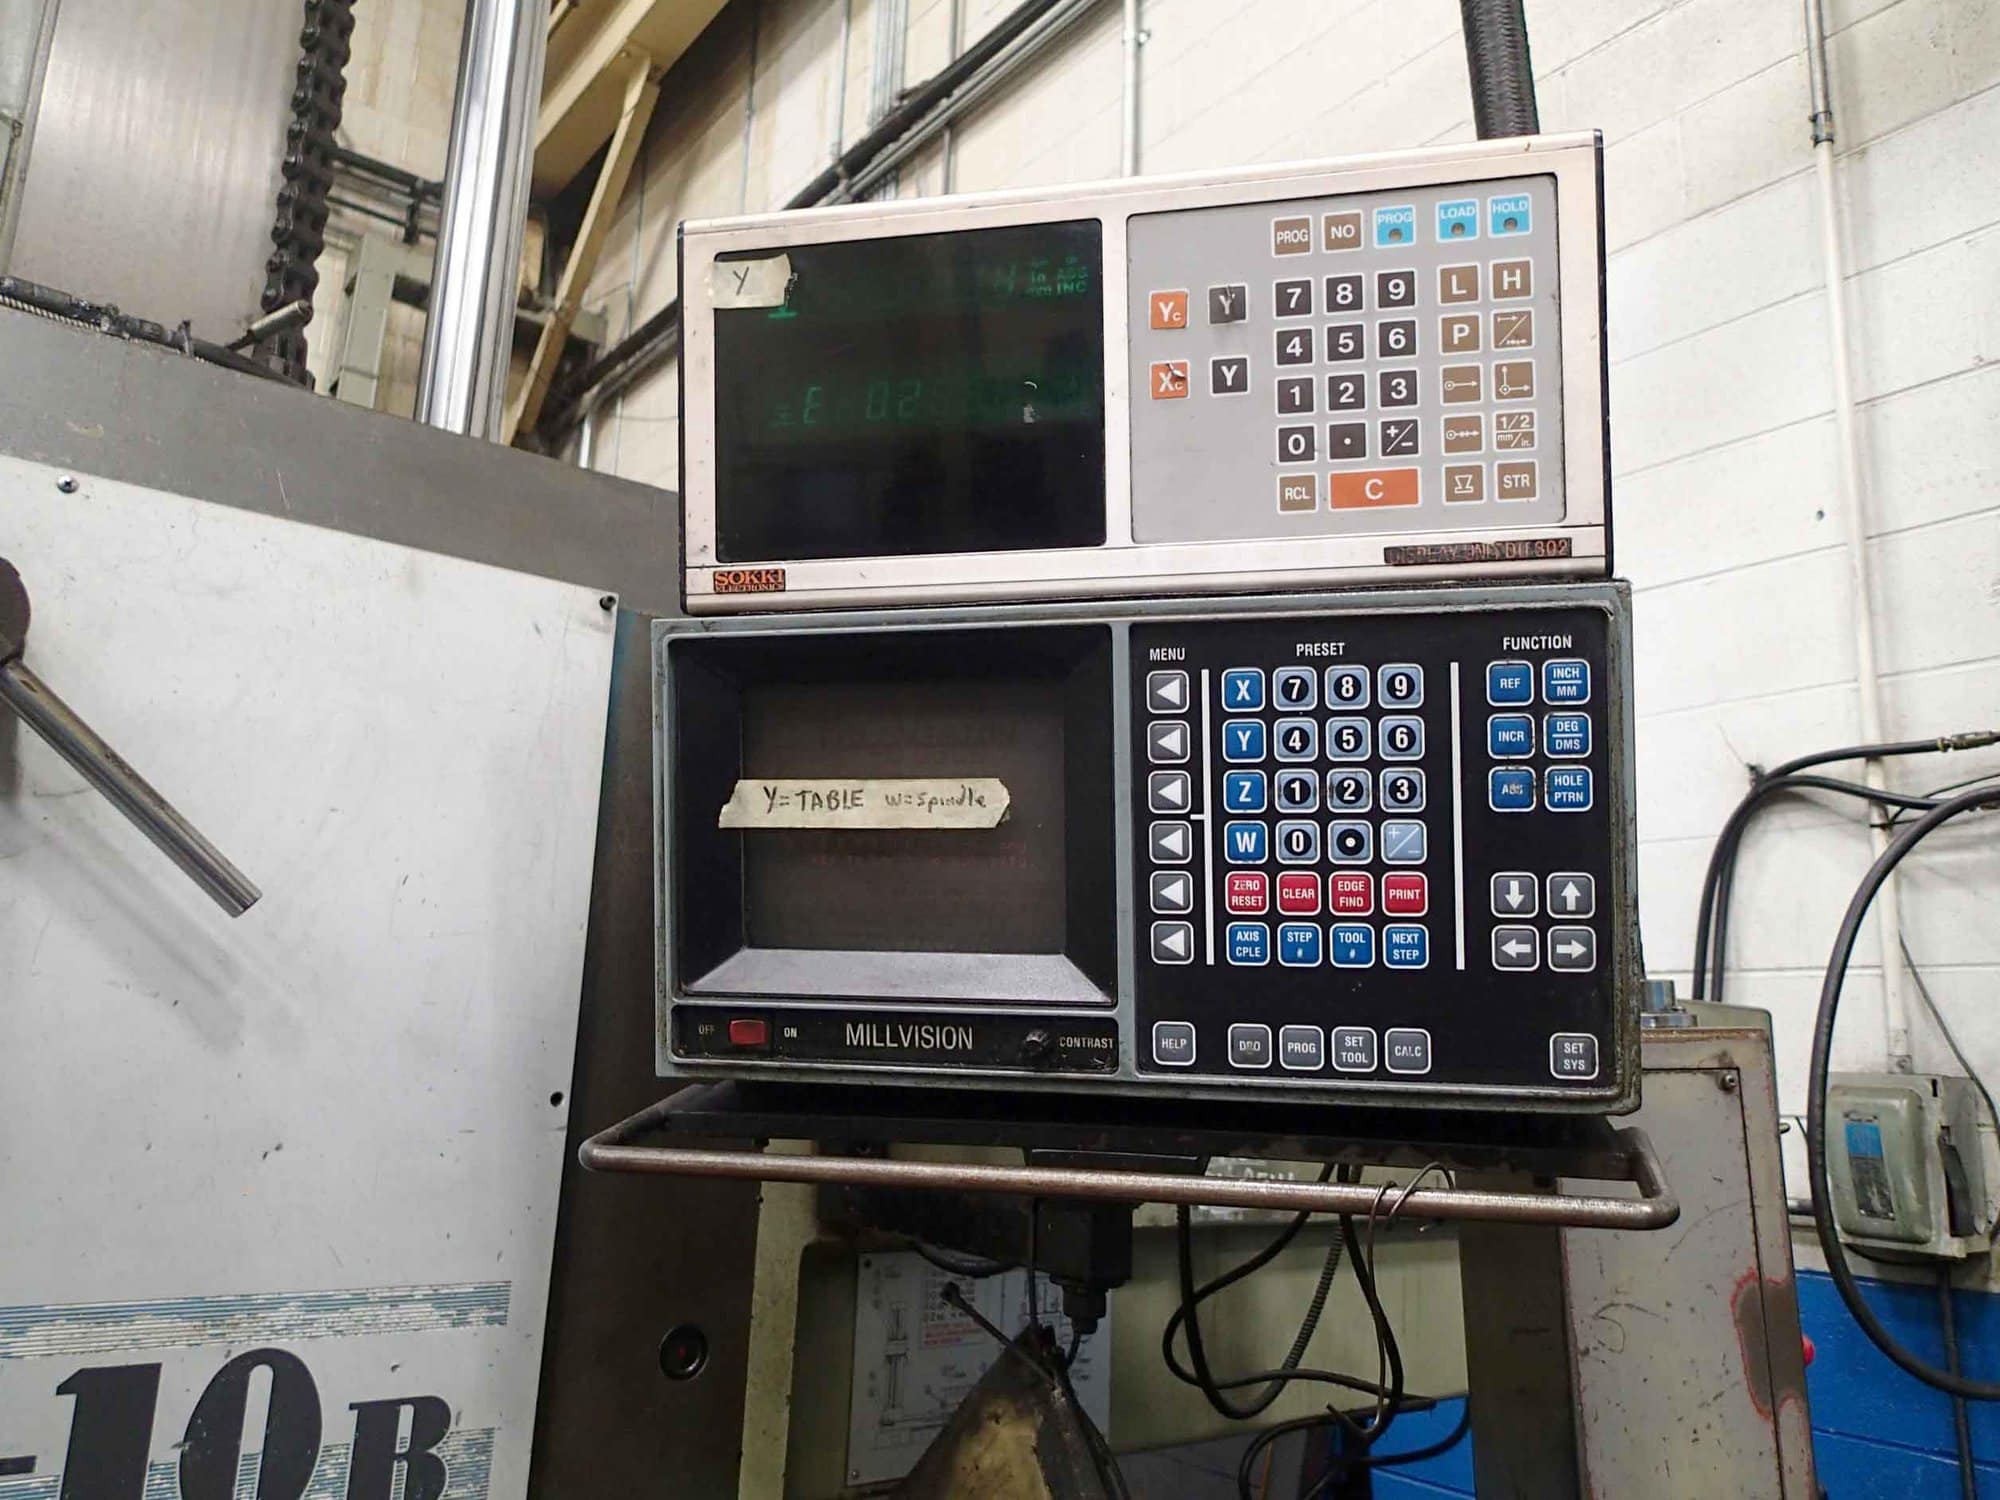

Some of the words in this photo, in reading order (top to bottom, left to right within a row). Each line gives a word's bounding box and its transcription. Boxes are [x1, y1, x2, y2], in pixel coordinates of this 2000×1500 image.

[1440, 205, 1475, 219] LOAD
[1492, 200, 1528, 214] HOLD
[1377, 211, 1413, 226] PROG
[1277, 228, 1309, 244] PROG
[1330, 224, 1355, 240] NO
[733, 266, 750, 296] Y
[1451, 276, 1466, 296] L
[1503, 270, 1520, 290] H
[1336, 283, 1353, 305] 8
[1388, 278, 1406, 300] 9
[1287, 289, 1302, 309] 7
[1389, 327, 1406, 348] 6
[1453, 324, 1469, 344] P
[1286, 338, 1303, 357] 4
[1337, 332, 1355, 353] 5
[1220, 365, 1238, 386] Y
[1290, 386, 1301, 405] 1
[1339, 383, 1355, 404] 2
[1391, 378, 1408, 400] 3
[1500, 415, 1531, 430] 1/2
[1287, 434, 1306, 455] 0
[1503, 474, 1530, 489] STR
[1285, 485, 1310, 501] RCL
[1365, 479, 1384, 501] C
[1535, 539, 1569, 558] 302
[715, 569, 784, 586] SOKKI
[1296, 642, 1345, 657] PRESET
[1503, 635, 1572, 650] FUNCTION
[1149, 648, 1185, 661] MENU
[1553, 667, 1580, 679] INCH
[1236, 680, 1251, 701] X
[1288, 679, 1301, 699] 7
[1341, 676, 1354, 698] 8
[1394, 675, 1407, 697] 9
[1500, 678, 1521, 689] REF
[1556, 686, 1577, 697] MM
[1556, 720, 1579, 732] DEG
[1237, 730, 1251, 751] Y
[1289, 730, 1302, 750] 4
[1342, 729, 1355, 750] 5
[1396, 727, 1408, 749] 6
[1498, 731, 1525, 742] INCR
[1555, 739, 1581, 750] DMS
[1554, 775, 1583, 786] HOLE
[1239, 781, 1252, 802] Z
[1291, 781, 1301, 802] 1
[1343, 780, 1356, 801] 2
[1396, 779, 1409, 800] 3
[1501, 783, 1524, 795] ABS
[1554, 791, 1584, 803] PTRN
[1235, 832, 1257, 853] W
[1291, 831, 1305, 852] 0
[1233, 880, 1260, 891] ZERO
[1338, 881, 1365, 892] EDGE
[1231, 895, 1263, 907] RESET
[1282, 888, 1315, 900] CLEAR
[1389, 889, 1421, 900] PRINT
[1339, 897, 1364, 907] FIND
[1236, 930, 1260, 942] AXIS
[1287, 931, 1313, 943] STEP
[1338, 932, 1366, 944] TOOL
[1392, 933, 1419, 945] NEXT
[1235, 946, 1261, 958] CPLE
[1392, 949, 1419, 960] STEP
[698, 1024, 715, 1036] OFF
[784, 1027, 798, 1039] ON
[845, 1023, 973, 1049] MILLVISION
[1059, 1036, 1114, 1050] CONTRAST
[1161, 1037, 1187, 1049] HELP
[1287, 1041, 1316, 1054] PROG
[1344, 1035, 1364, 1047] SET
[1564, 1042, 1585, 1054] SET
[1341, 1052, 1368, 1064] TOOL
[1394, 1045, 1422, 1057] CALC
[1563, 1059, 1585, 1071] SYS
